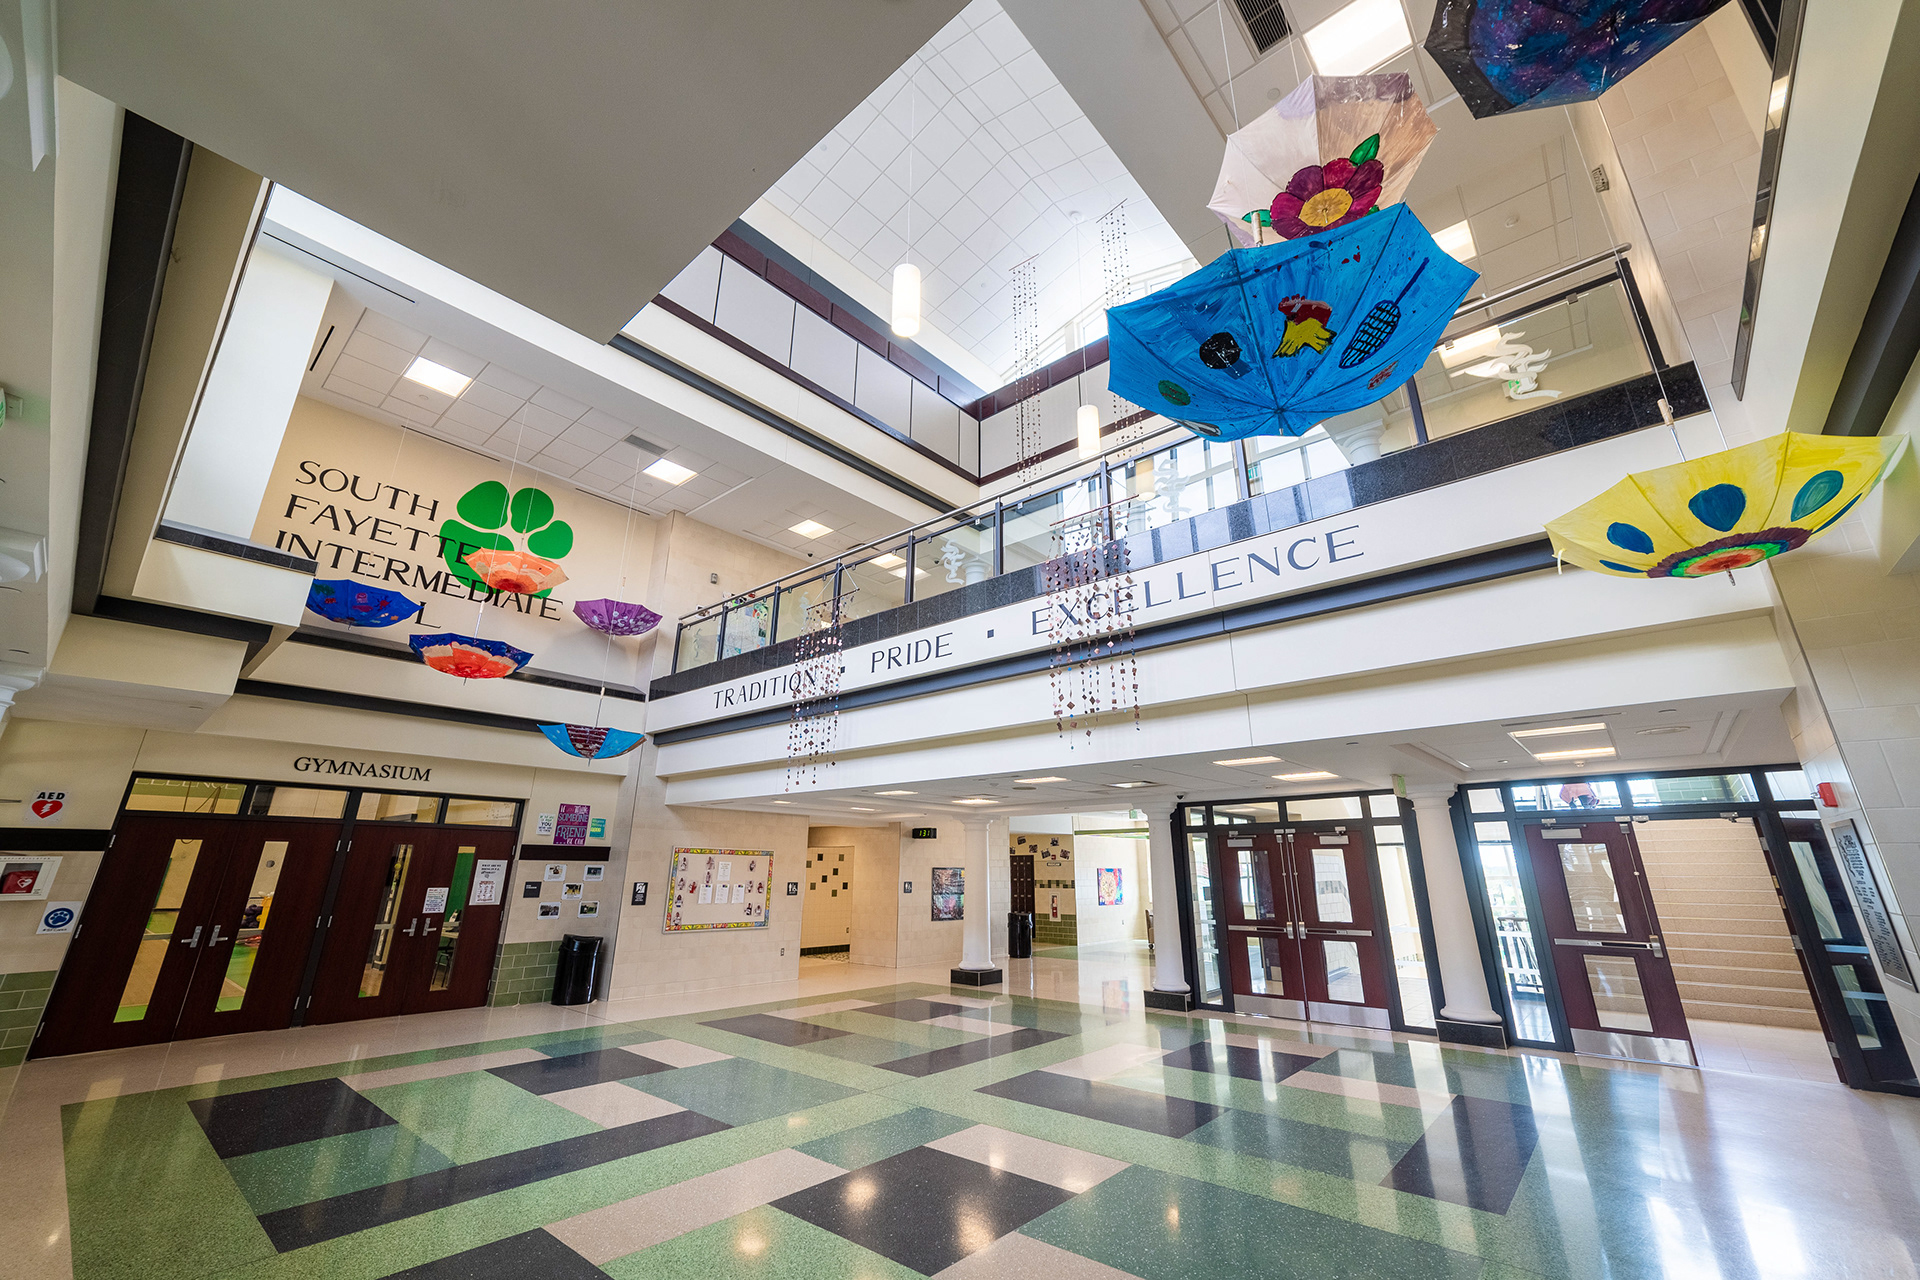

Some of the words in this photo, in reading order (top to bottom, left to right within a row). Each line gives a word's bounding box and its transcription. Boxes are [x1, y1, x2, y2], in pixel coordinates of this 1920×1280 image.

[296, 460, 439, 521] SOUTH
[284, 493, 483, 566] FAYETTE
[274, 530, 563, 621] INTERMEDIATE
[713, 667, 817, 709] TRADITION
[871, 632, 953, 673] PRIDE
[1032, 524, 1364, 635] EXCELLENCE
[293, 756, 432, 782] GYMNASIUM
[37, 791, 65, 800] AED
[556, 825, 586, 840] FRIEND
[558, 813, 588, 822] SOMEONE
